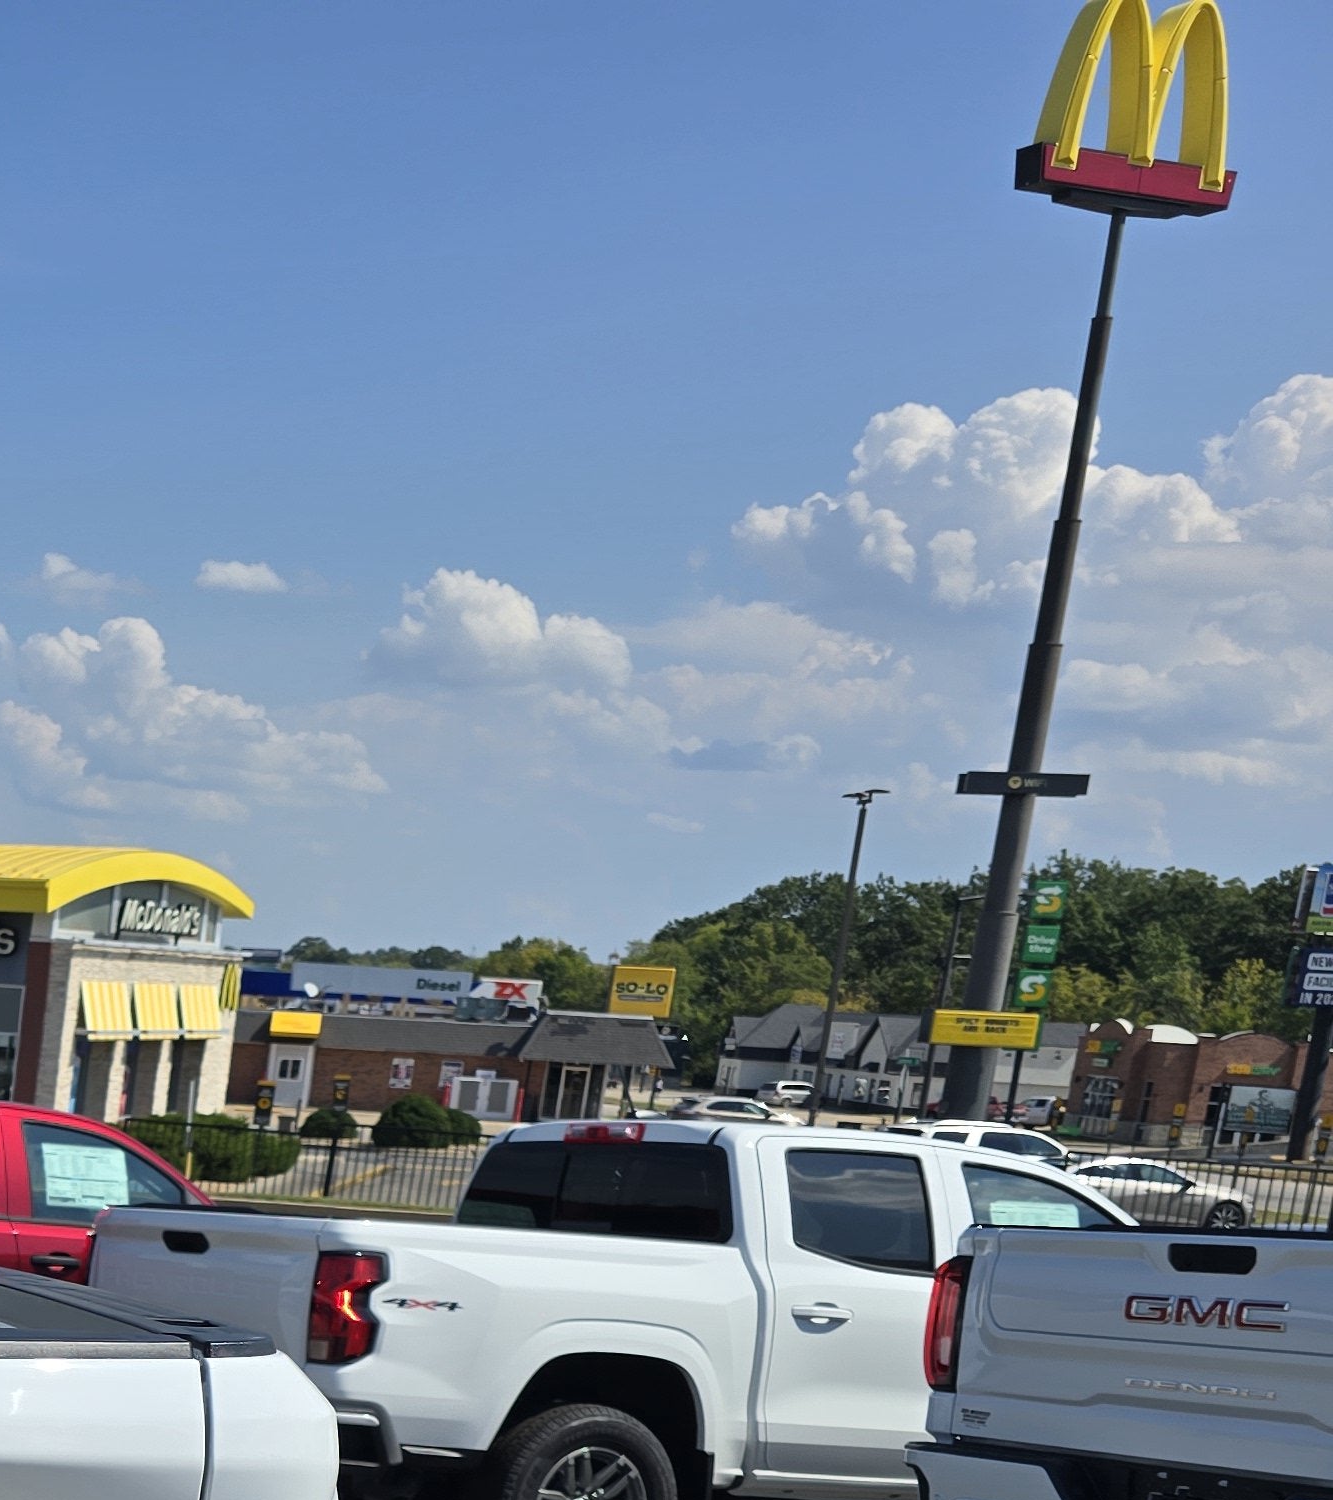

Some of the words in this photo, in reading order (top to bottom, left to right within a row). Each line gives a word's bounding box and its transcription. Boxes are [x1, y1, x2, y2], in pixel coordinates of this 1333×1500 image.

[1027, 935, 1057, 946] Drive
[1029, 944, 1053, 954] thru
[416, 978, 462, 992] Diesel
[615, 982, 669, 996] SO-LO
[1299, 992, 1313, 1004] IN
[1123, 1292, 1291, 1333] GMC
[1124, 1377, 1277, 1401] DENALI
